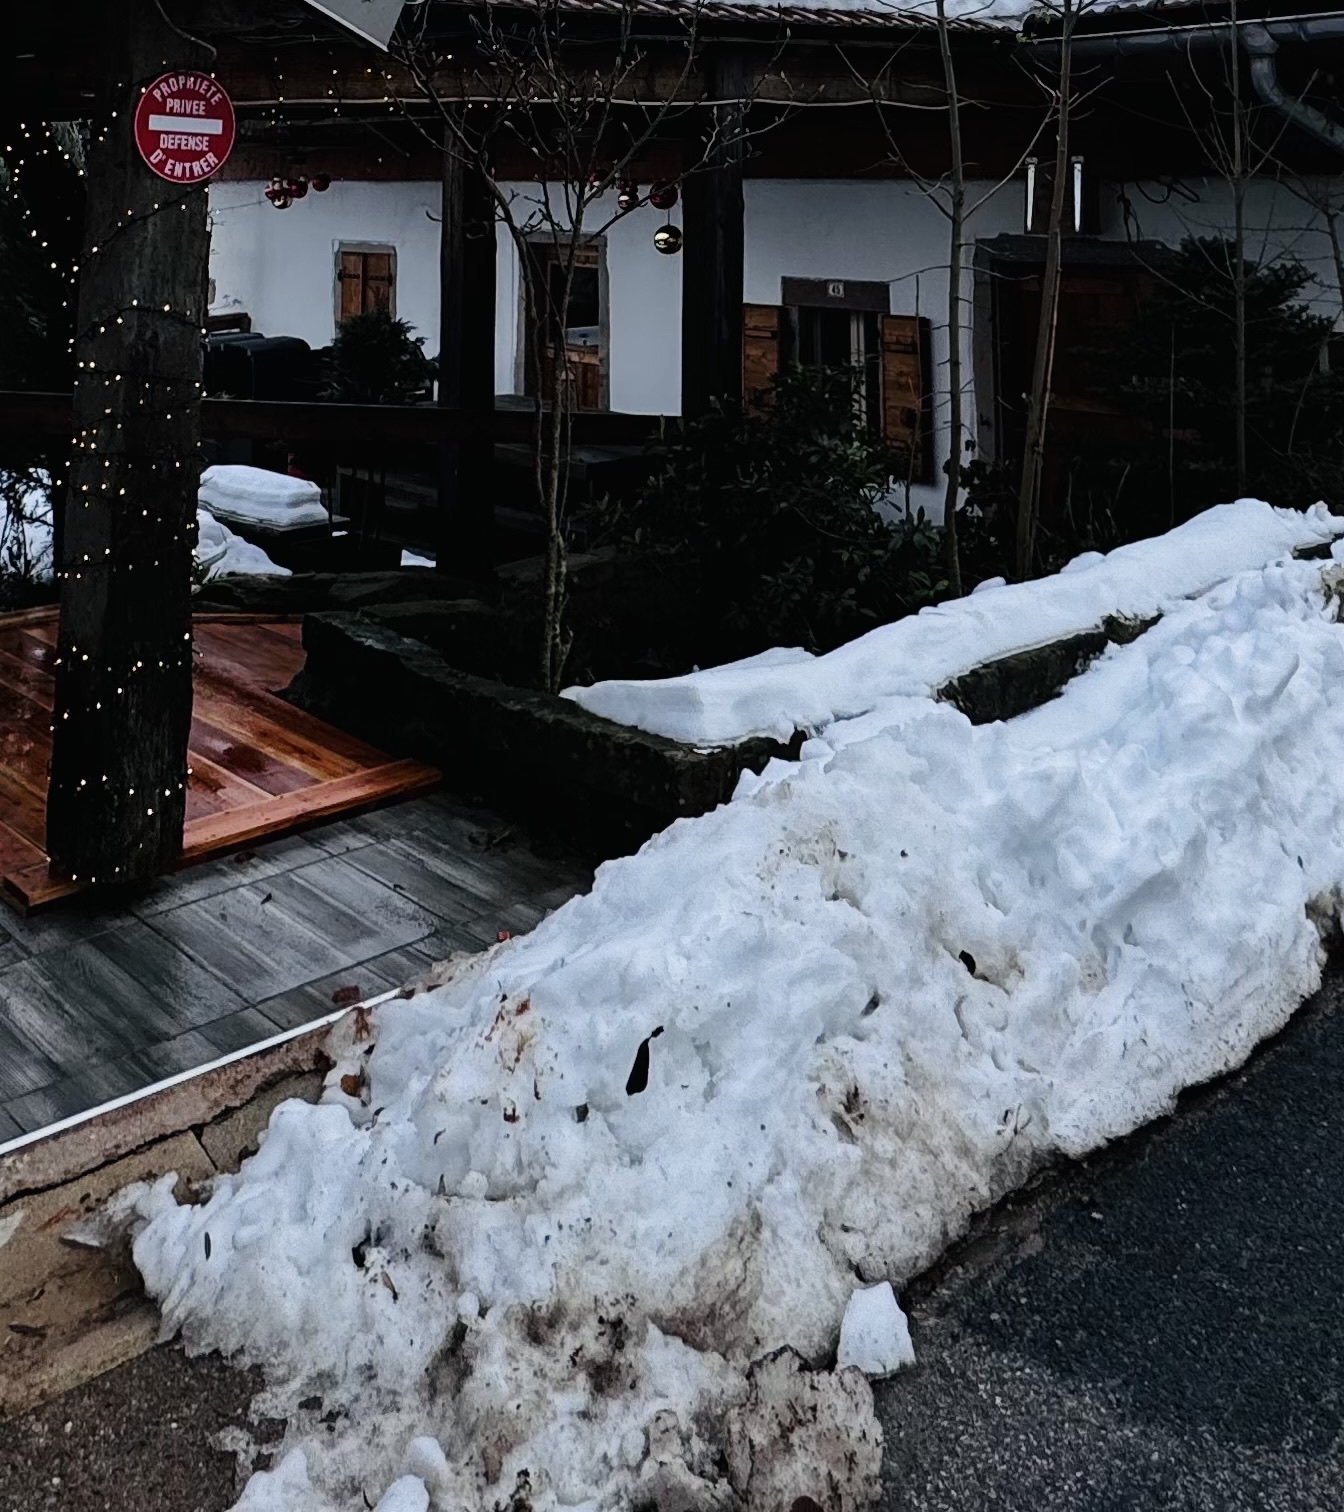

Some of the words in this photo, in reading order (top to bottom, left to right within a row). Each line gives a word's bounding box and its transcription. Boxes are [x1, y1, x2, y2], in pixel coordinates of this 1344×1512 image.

[153, 75, 223, 106] PROPRIETE
[166, 98, 206, 115] PRIVEE
[159, 134, 210, 151] DEFENSE
